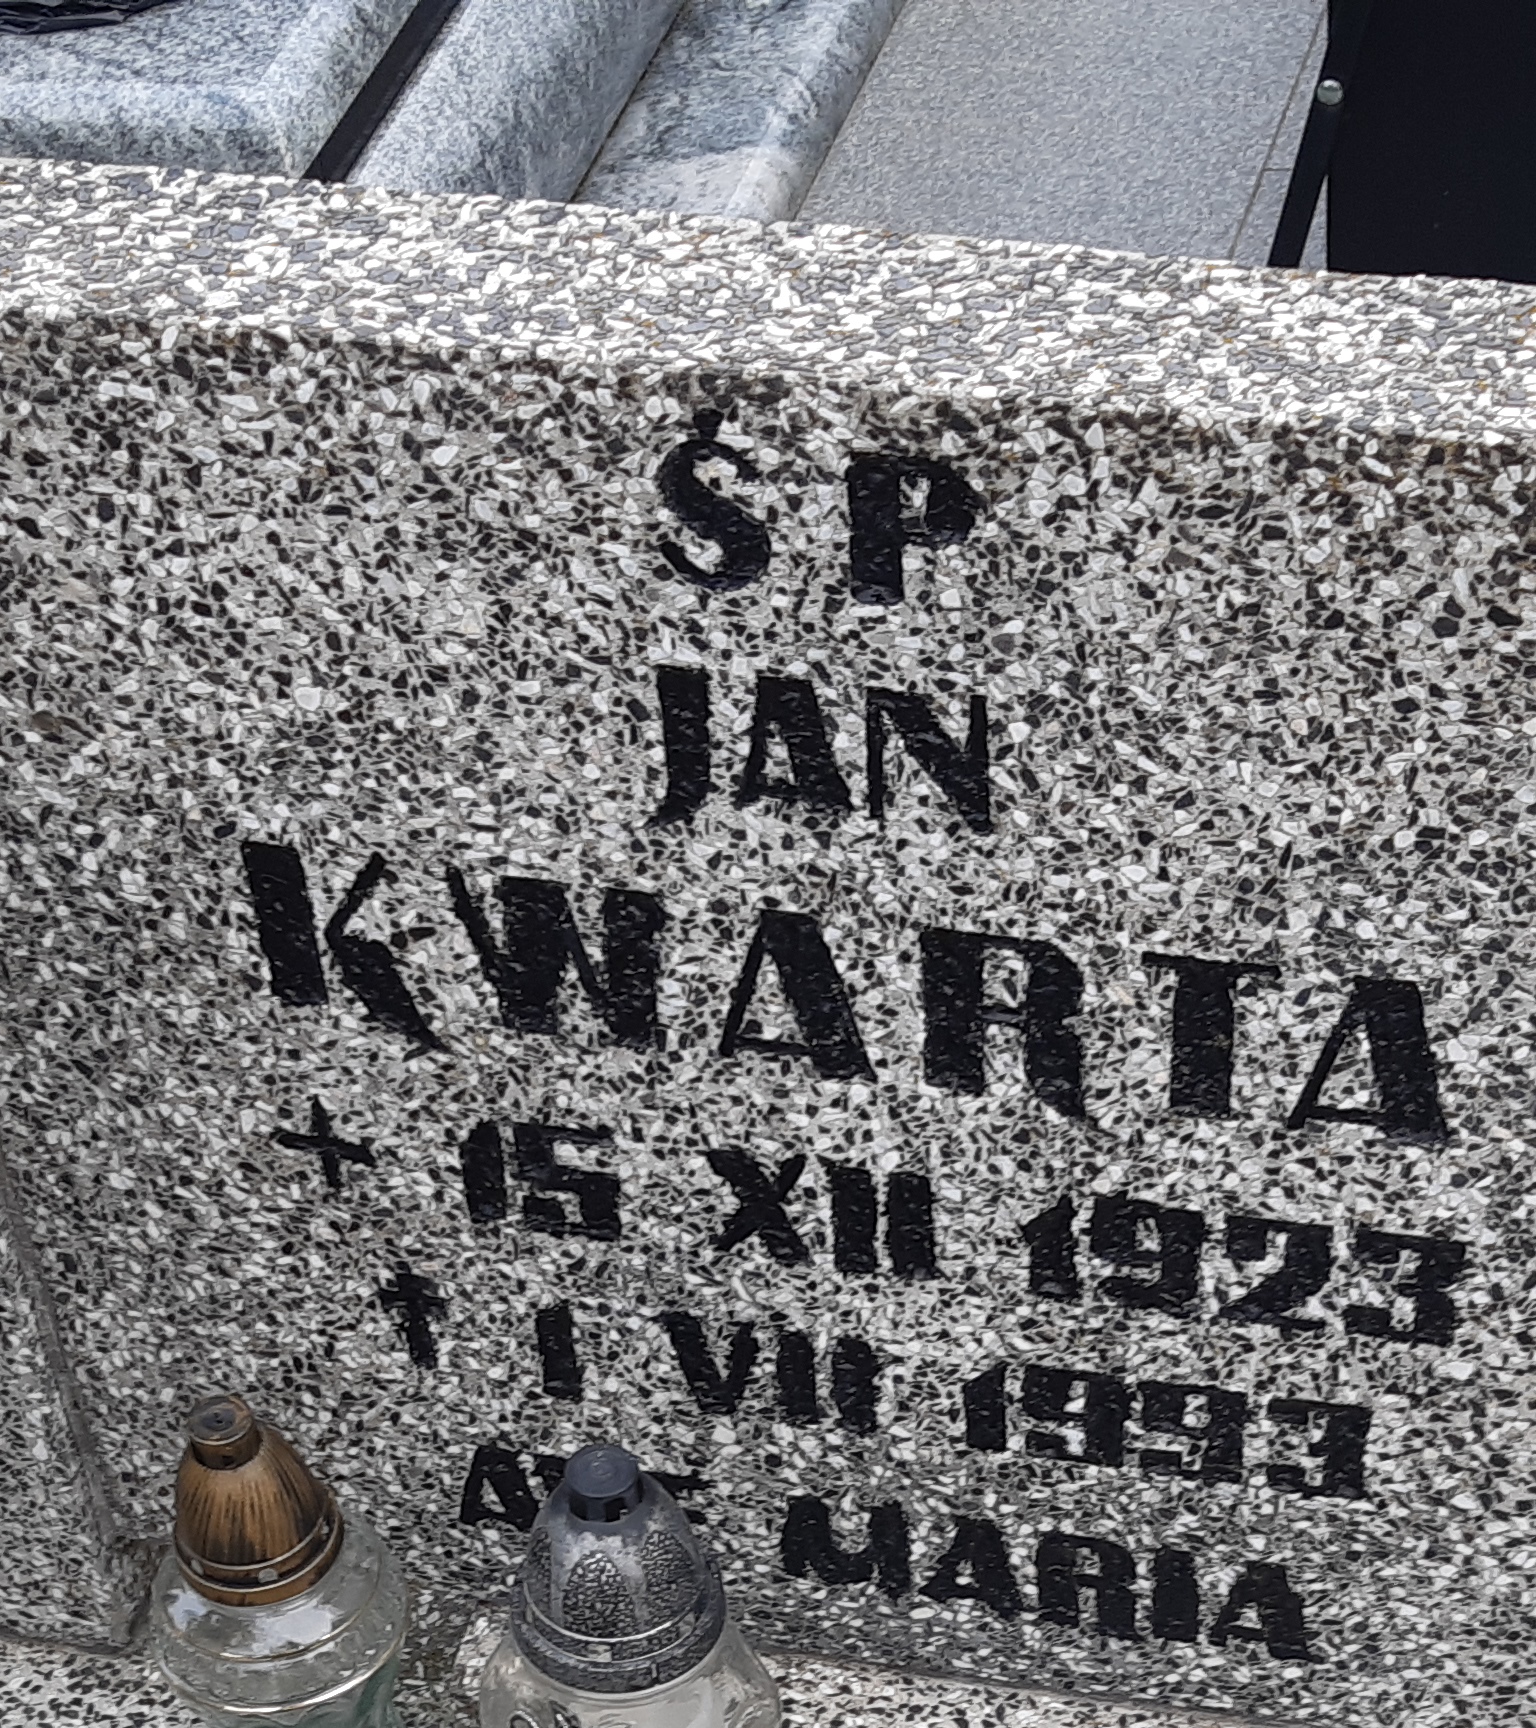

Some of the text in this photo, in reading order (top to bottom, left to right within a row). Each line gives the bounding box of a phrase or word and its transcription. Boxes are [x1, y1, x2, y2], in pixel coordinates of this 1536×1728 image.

[844, 450, 986, 606] P
[651, 662, 992, 832] JAN
[240, 838, 1454, 1146] KWARTA
[706, 1148, 942, 1280] XII
[1020, 1192, 1467, 1348] 1923
[666, 1308, 879, 1435] VII
[964, 1360, 1372, 1500] 1993
[780, 1495, 1326, 1666] MARIA
